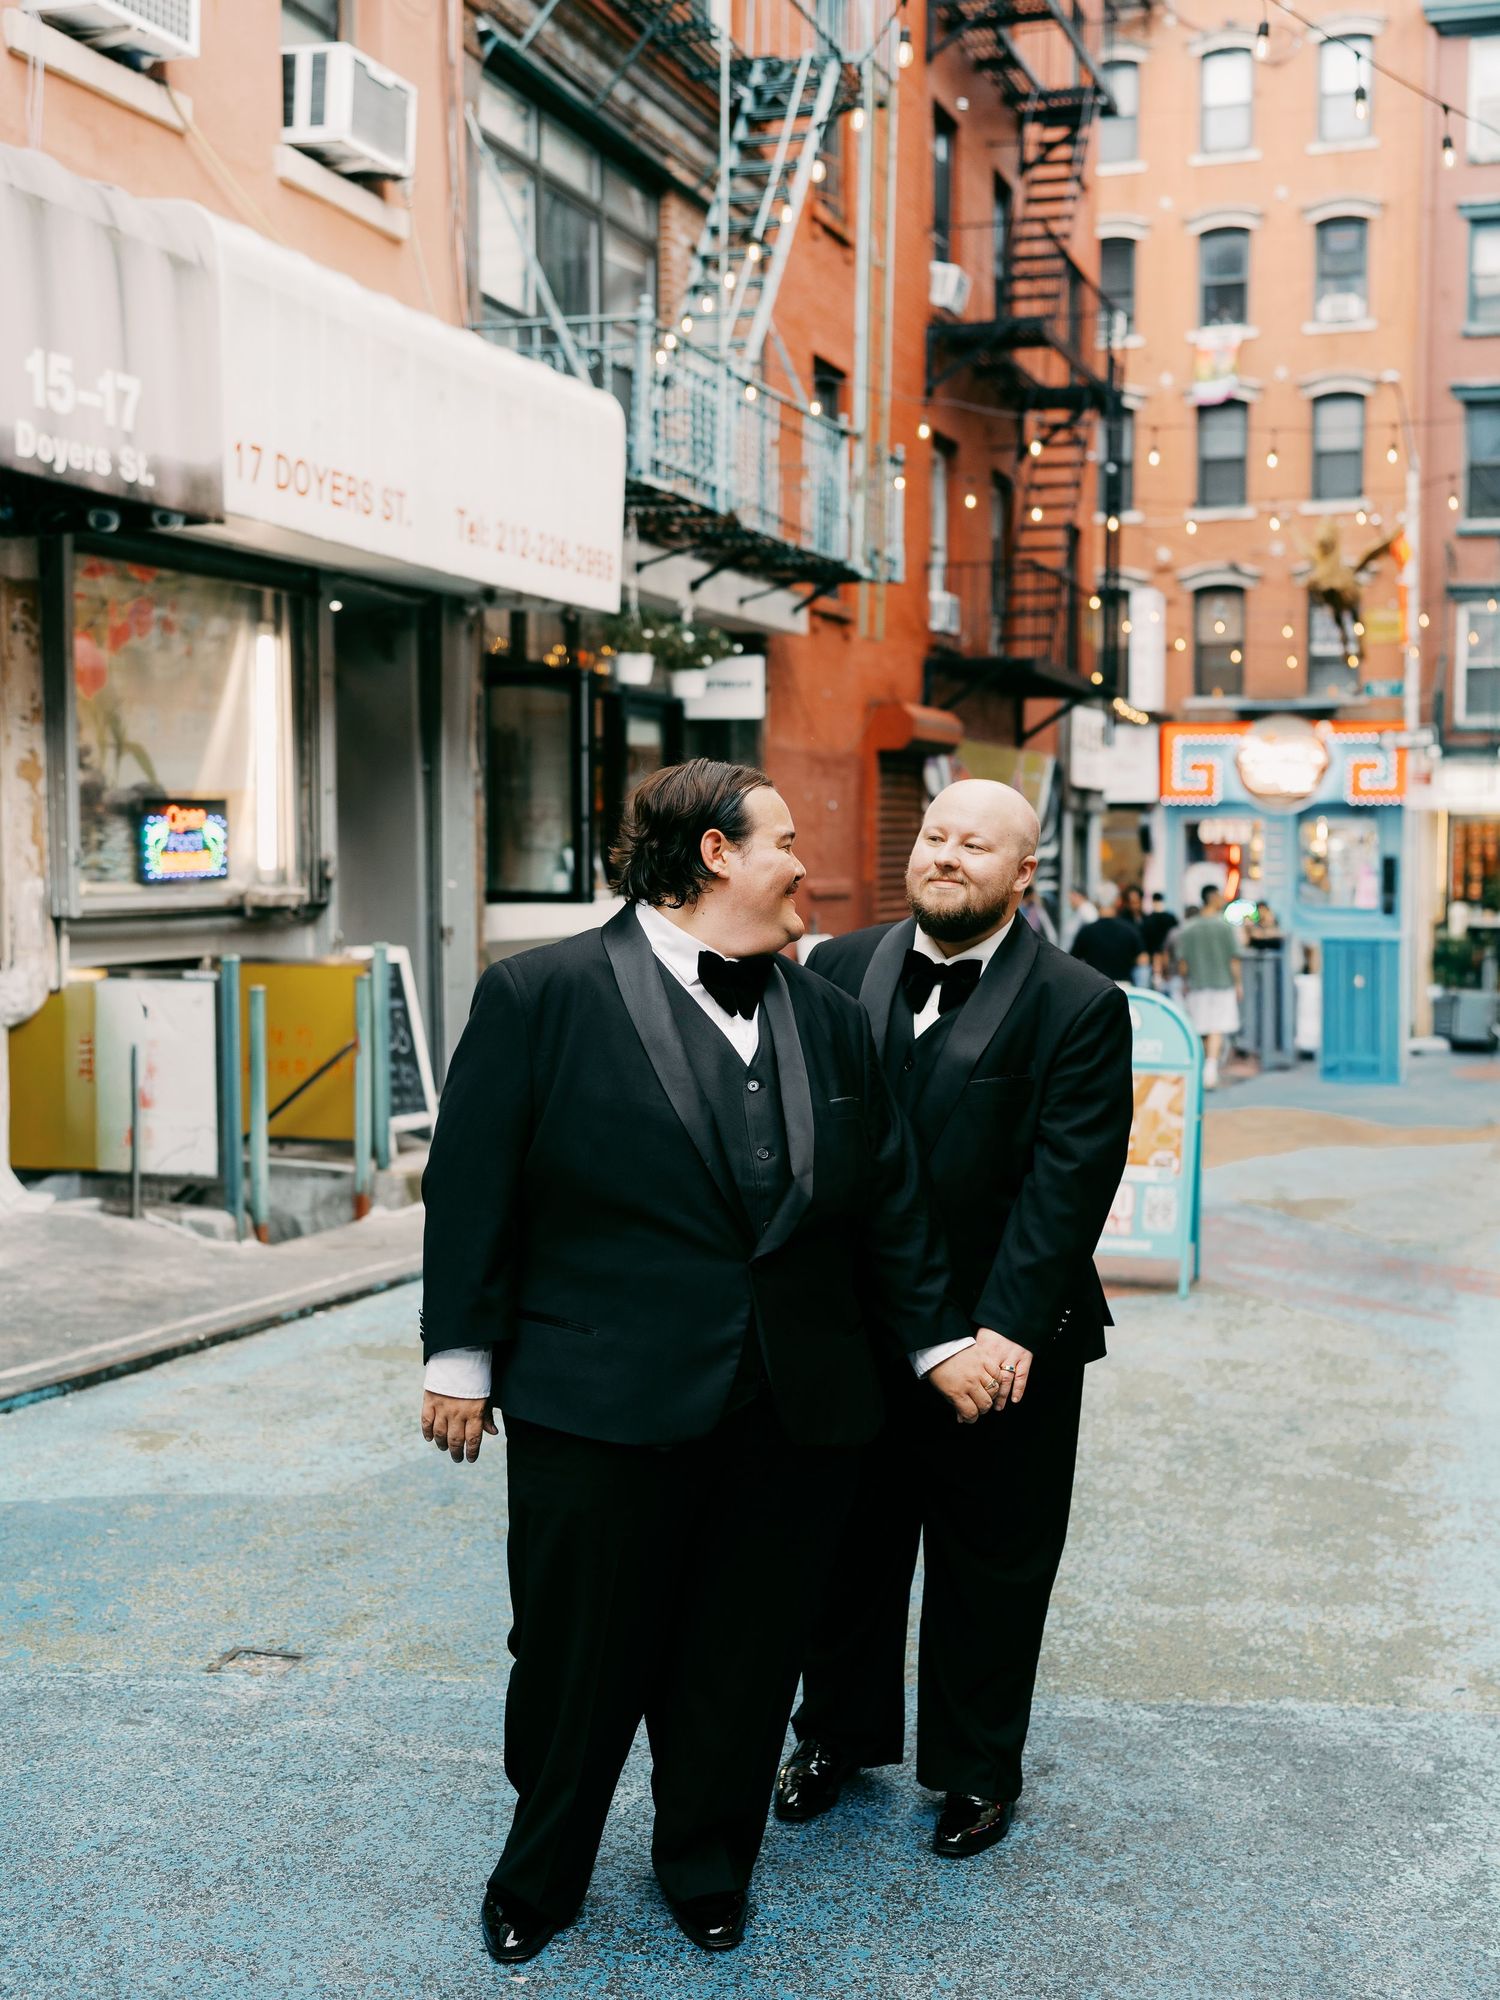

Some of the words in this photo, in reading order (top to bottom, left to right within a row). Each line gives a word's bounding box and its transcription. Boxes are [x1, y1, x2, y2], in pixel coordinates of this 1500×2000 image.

[14, 419, 112, 476] Doyers
[119, 446, 155, 487] St.
[235, 442, 262, 484] 17
[275, 453, 374, 515] DOYERS
[382, 487, 412, 526] ST.
